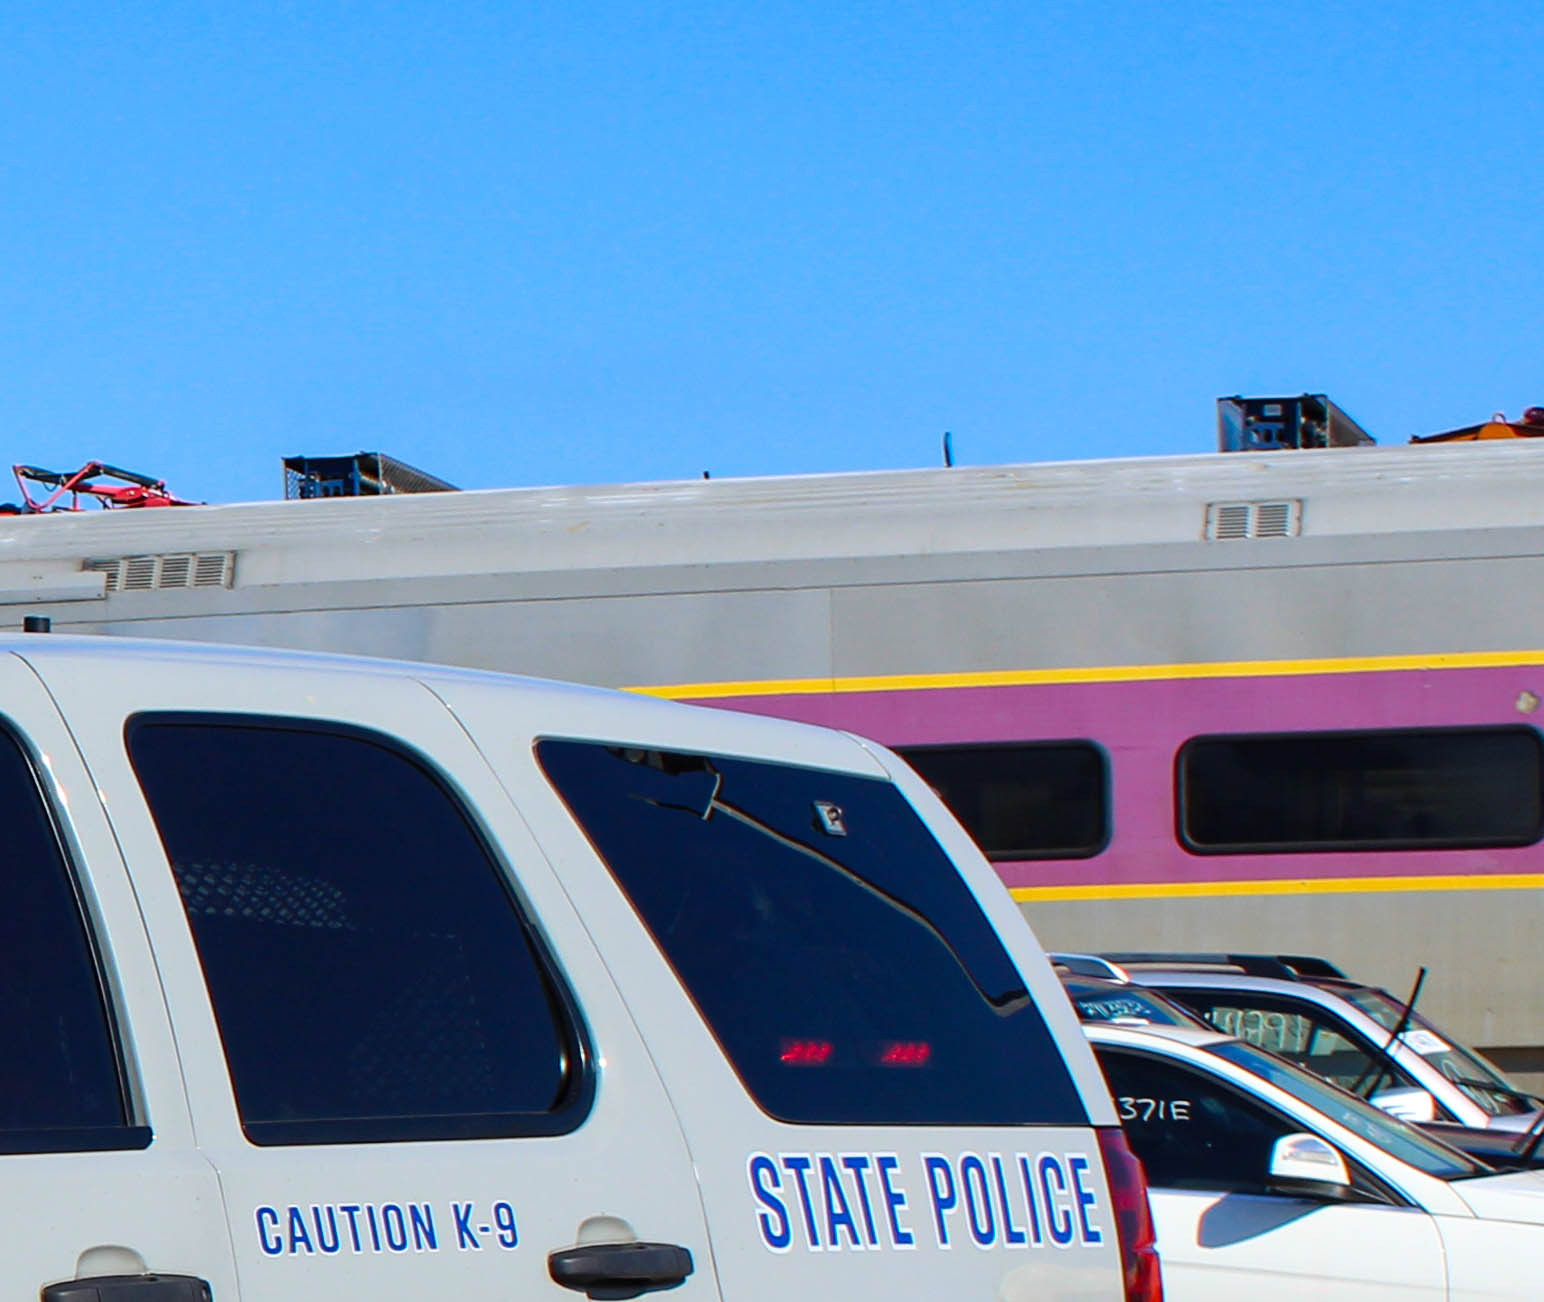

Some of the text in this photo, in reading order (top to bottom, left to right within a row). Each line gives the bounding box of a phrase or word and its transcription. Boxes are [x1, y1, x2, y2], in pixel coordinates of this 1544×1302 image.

[256, 1201, 520, 1256] CAUTION K-9
[750, 1154, 1104, 1250] STATE POLICE
